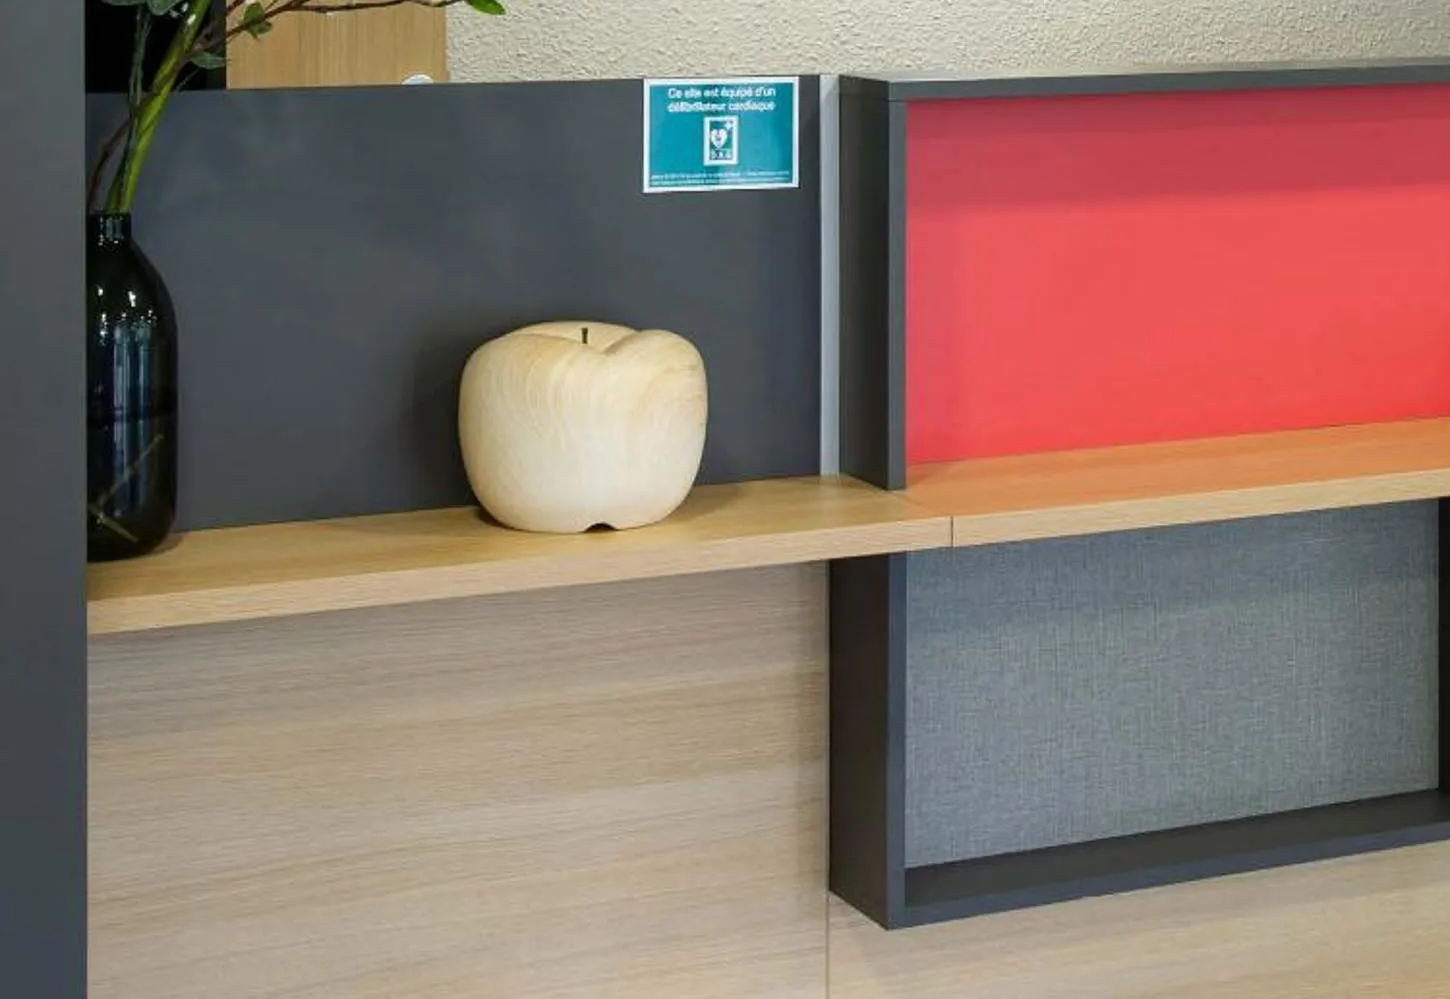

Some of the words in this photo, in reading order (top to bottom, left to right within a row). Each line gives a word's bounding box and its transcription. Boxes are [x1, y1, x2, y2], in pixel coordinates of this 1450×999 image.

[667, 87, 682, 99] Ce
[684, 87, 701, 98] site
[703, 86, 719, 98] est
[720, 86, 753, 98] équipé
[755, 85, 776, 97] d'un
[728, 100, 776, 112] cardiaque
